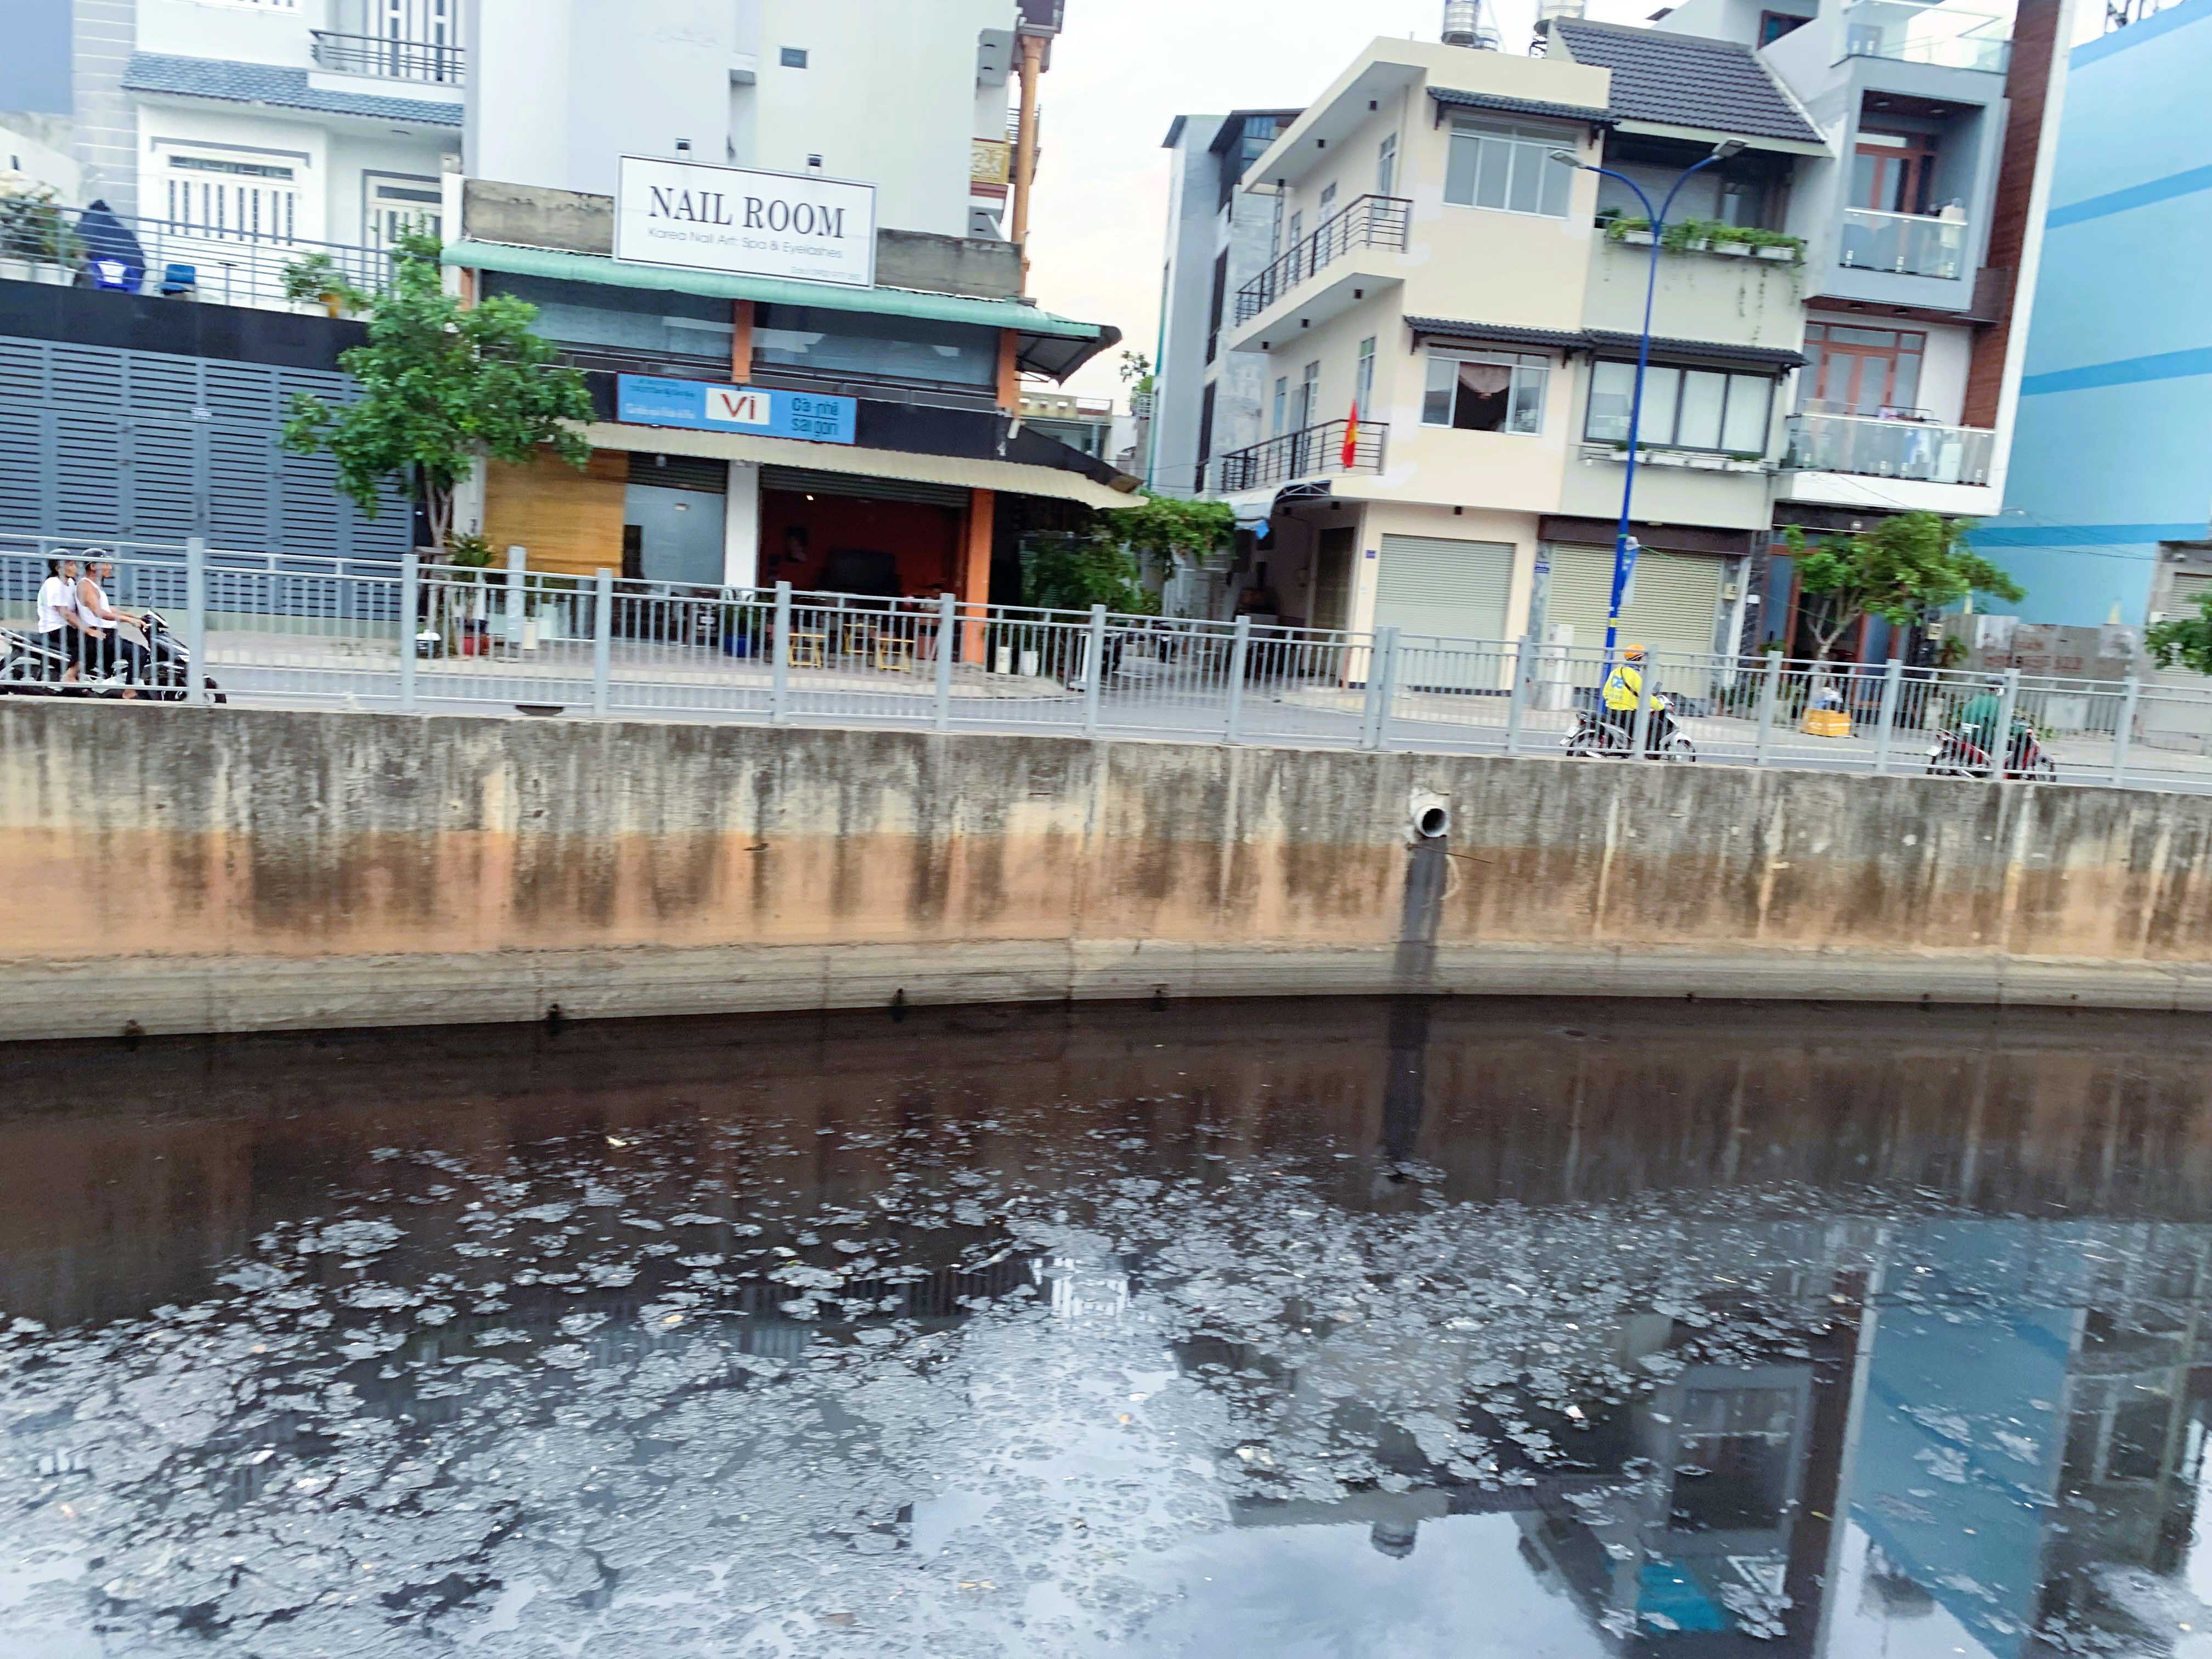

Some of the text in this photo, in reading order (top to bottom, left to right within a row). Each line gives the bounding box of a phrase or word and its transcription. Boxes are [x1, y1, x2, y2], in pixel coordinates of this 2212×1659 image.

[648, 185, 845, 238] NAIL ROOM
[648, 227, 843, 258] Korea Nail Art Spa & Eyelashes
[720, 393, 756, 420] Vi
